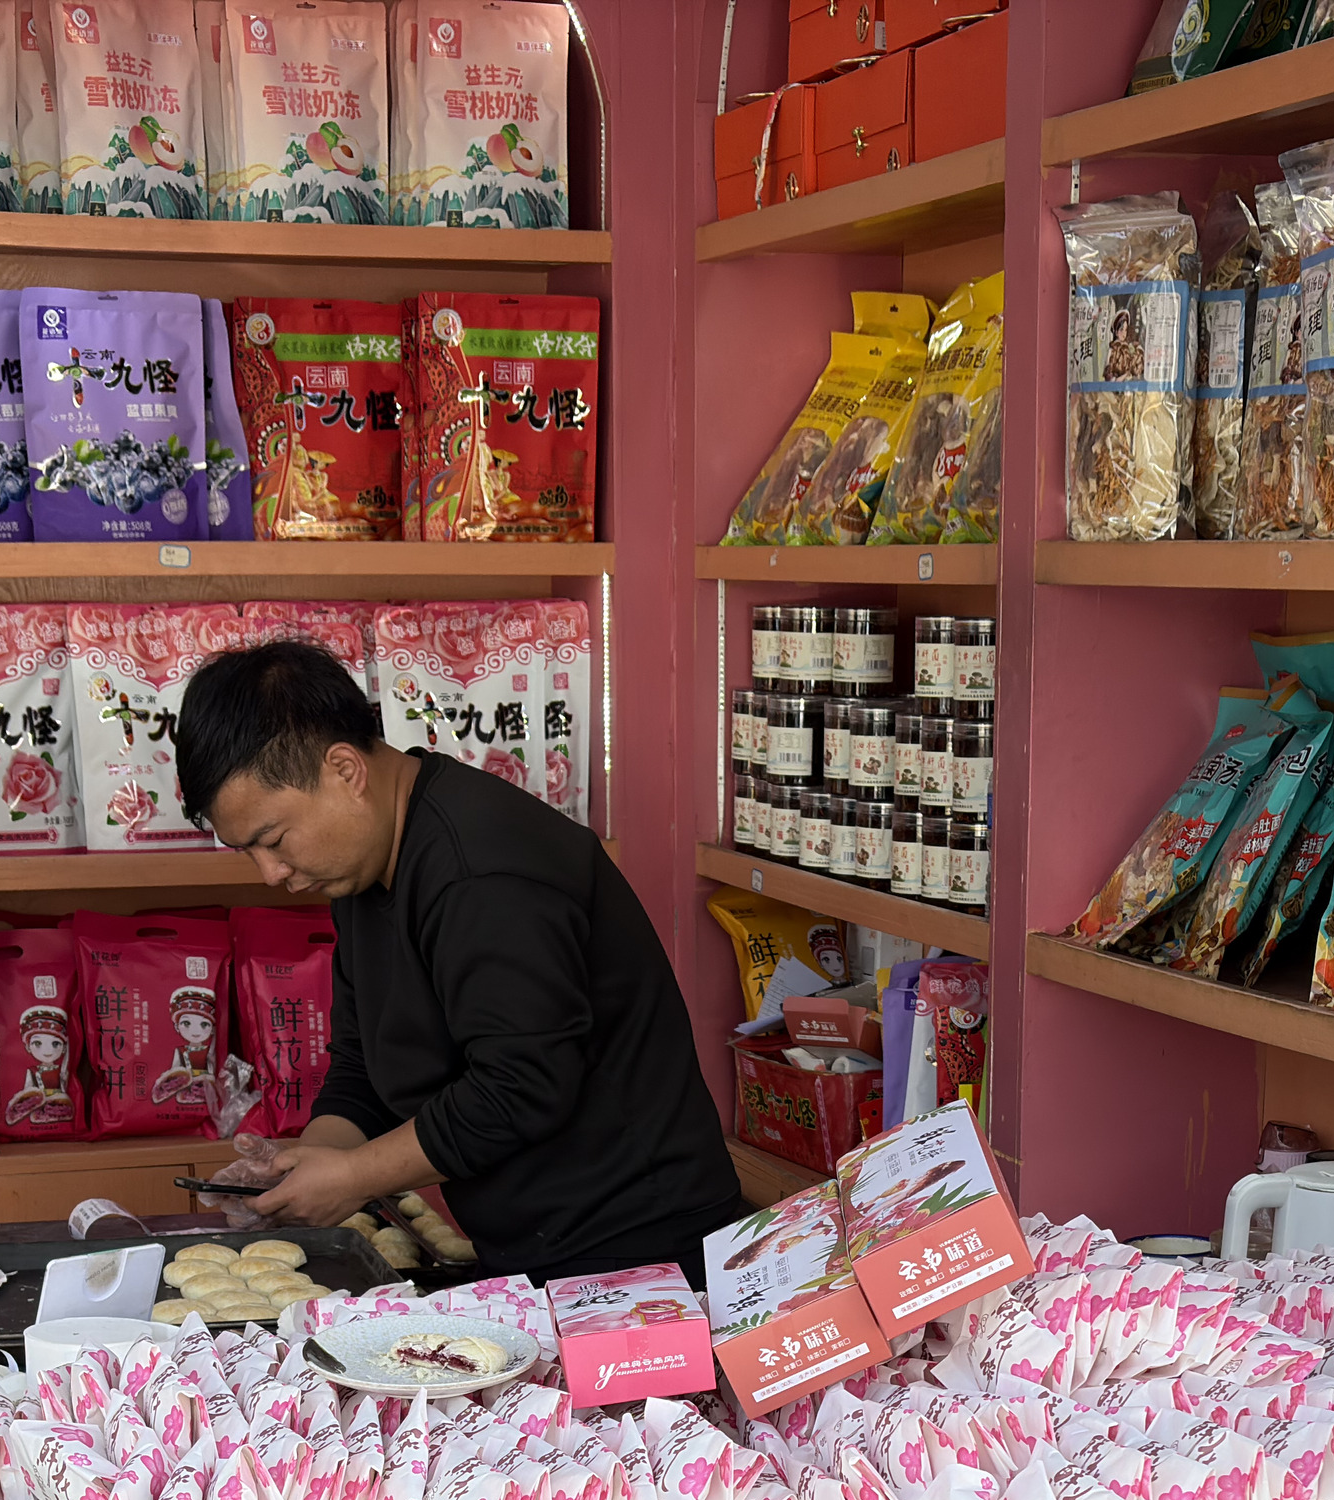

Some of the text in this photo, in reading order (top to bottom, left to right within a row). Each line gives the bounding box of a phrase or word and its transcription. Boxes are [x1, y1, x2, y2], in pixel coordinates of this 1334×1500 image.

[105, 50, 155, 82] 益生元
[281, 61, 341, 87] 益生元
[464, 64, 523, 90] 益生元
[83, 75, 181, 115] 雪桃奶冻
[262, 85, 362, 120] 雪桃奶冻
[444, 89, 540, 123] 雪桃奶冻
[81, 349, 116, 361] 云南
[46, 346, 179, 409] 十九怪
[307, 366, 349, 388] 云南
[493, 361, 535, 385] 云南
[273, 375, 402, 433] 十九怪
[457, 370, 591, 431] 十九怪
[131, 692, 157, 704] 云南
[439, 692, 464, 702] 云南
[405, 691, 531, 746] 十九怪
[1186, 752, 1246, 790] 菌汤
[94, 984, 129, 1101] 鲜花饼
[270, 997, 303, 1112] 鲜花饼
[898, 1231, 985, 1282] 云南味道
[619, 1353, 685, 1369] 经典云南风味
[758, 1322, 841, 1368] 云南味道
[595, 1361, 643, 1391] Yunnan
